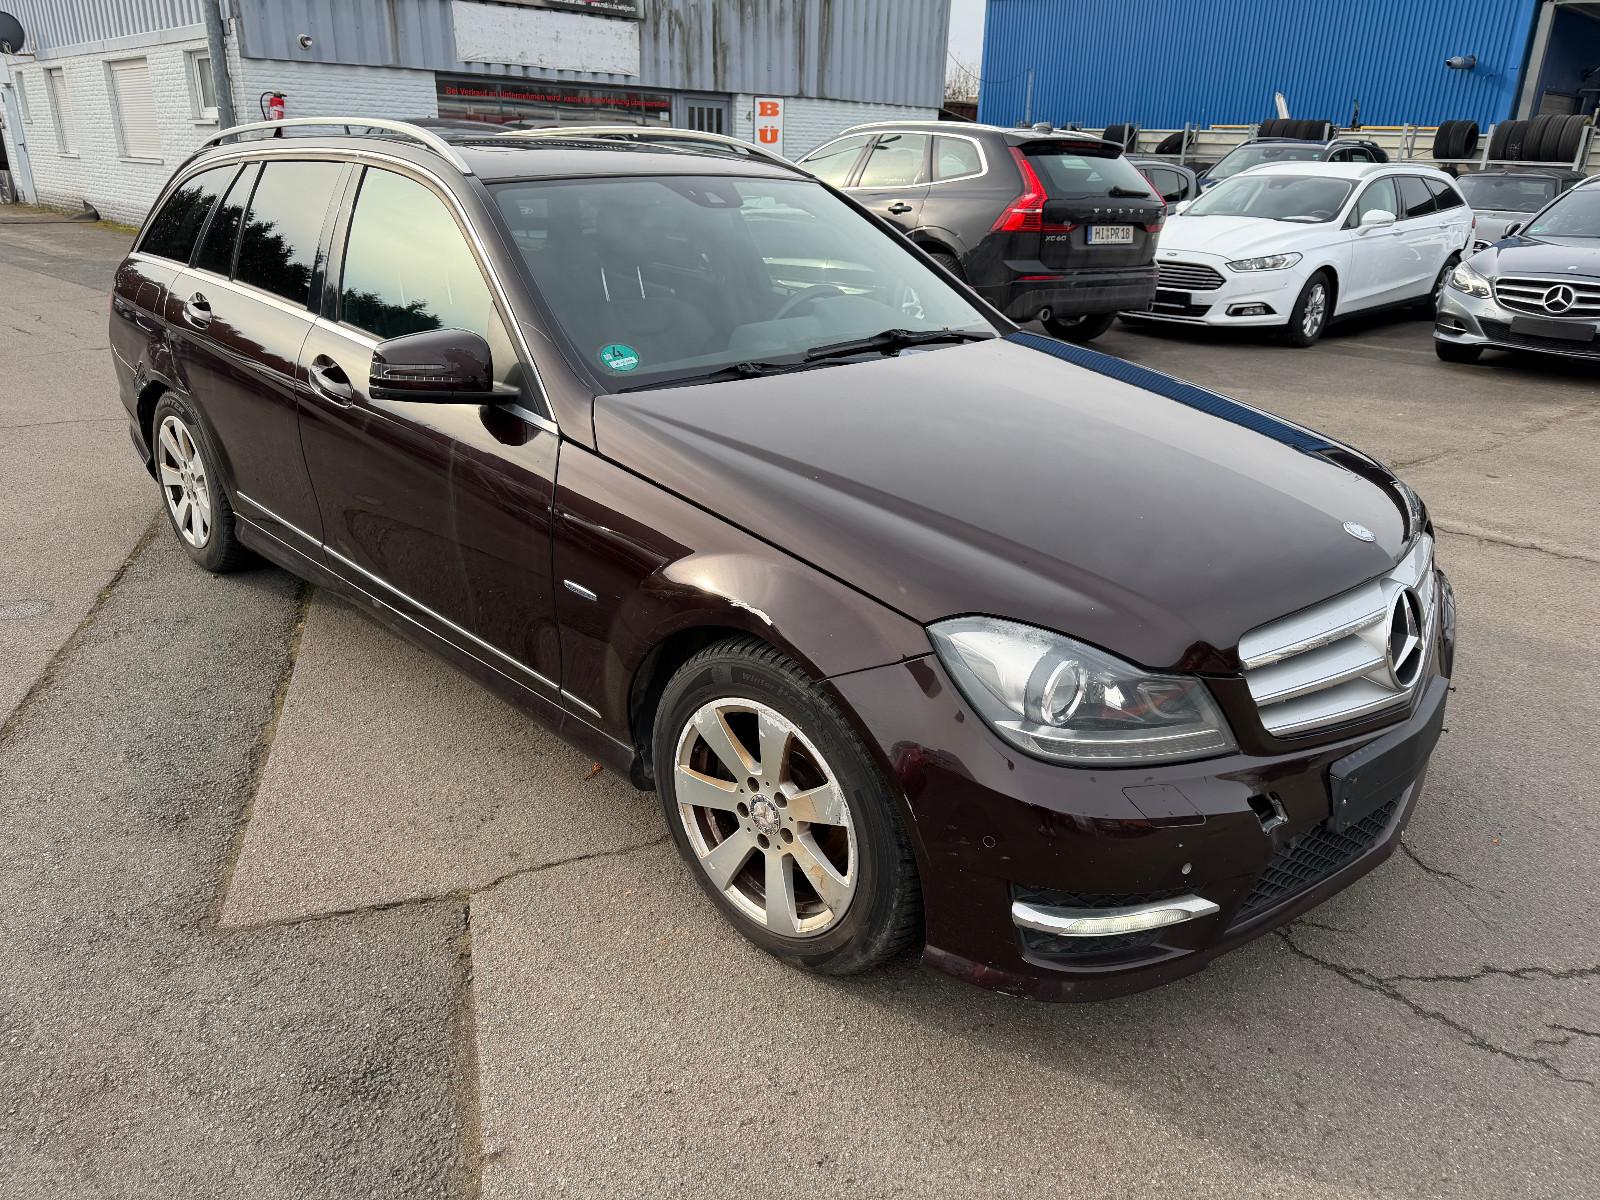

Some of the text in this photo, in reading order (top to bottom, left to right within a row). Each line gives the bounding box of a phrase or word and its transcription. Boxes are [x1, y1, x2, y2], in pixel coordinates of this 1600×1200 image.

[445, 86, 458, 95] Bei
[460, 88, 488, 97] Verkauf
[500, 90, 545, 101] Unternehmen
[612, 346, 624, 357] 4
